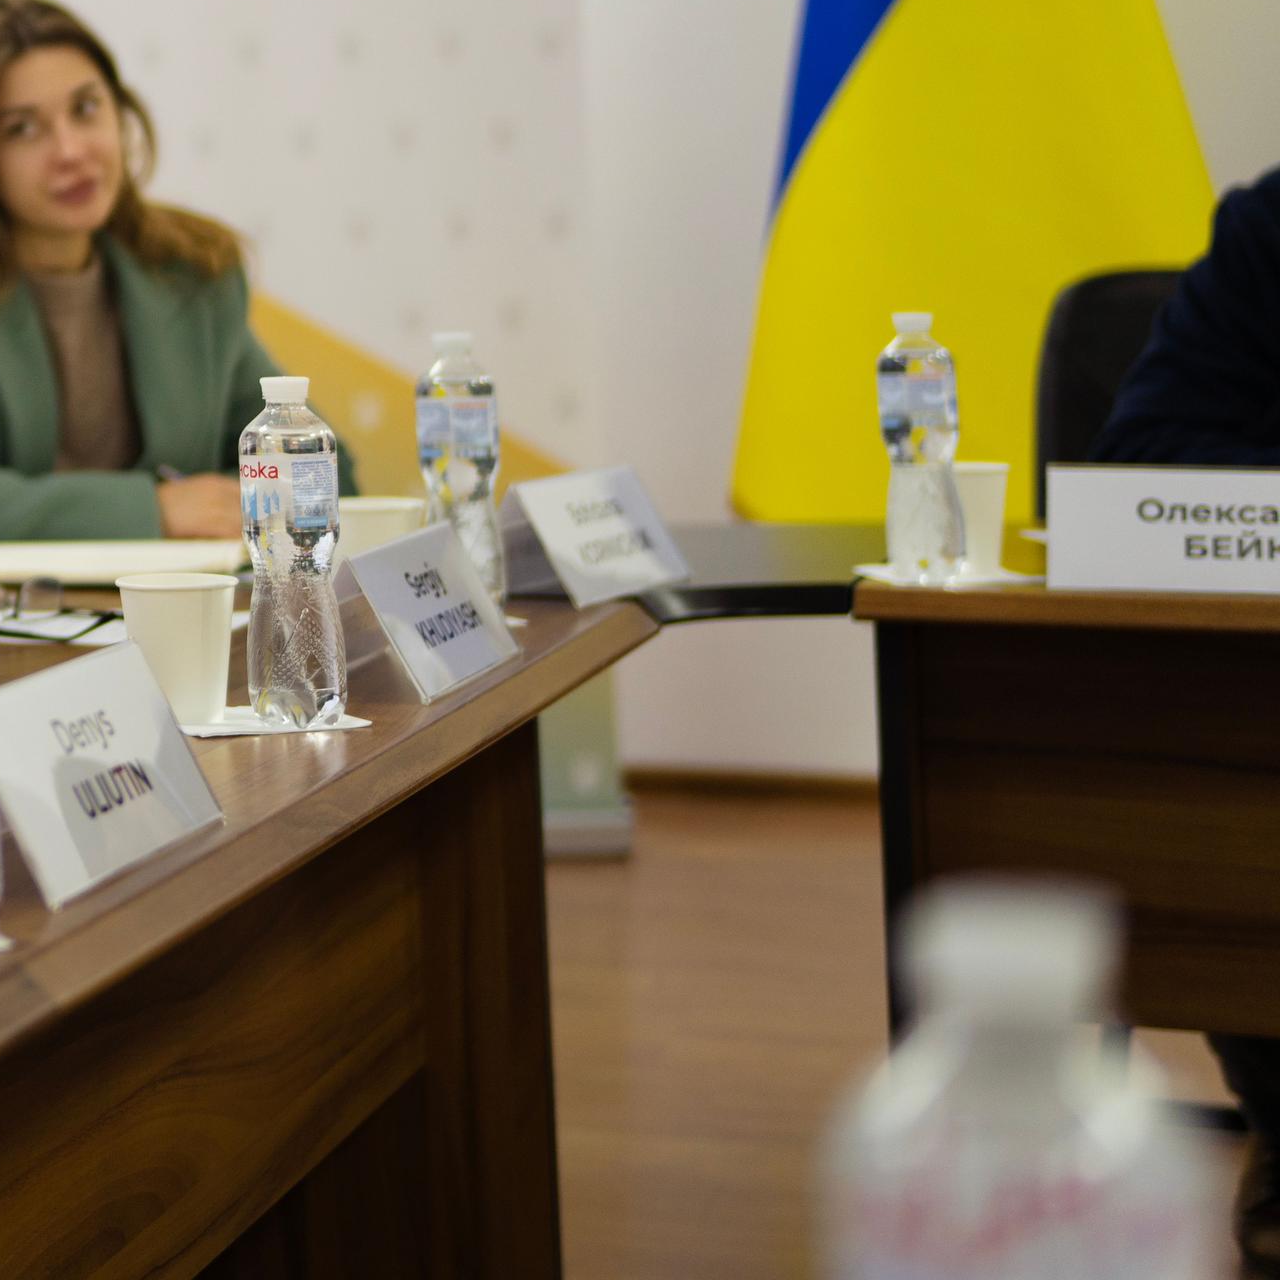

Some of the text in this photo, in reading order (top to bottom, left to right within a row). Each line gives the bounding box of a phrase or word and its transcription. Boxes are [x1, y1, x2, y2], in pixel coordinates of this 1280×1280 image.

[1137, 498, 1279, 524] Олекса
[50, 709, 115, 753] Denys
[72, 759, 153, 818] ULIUTIN
